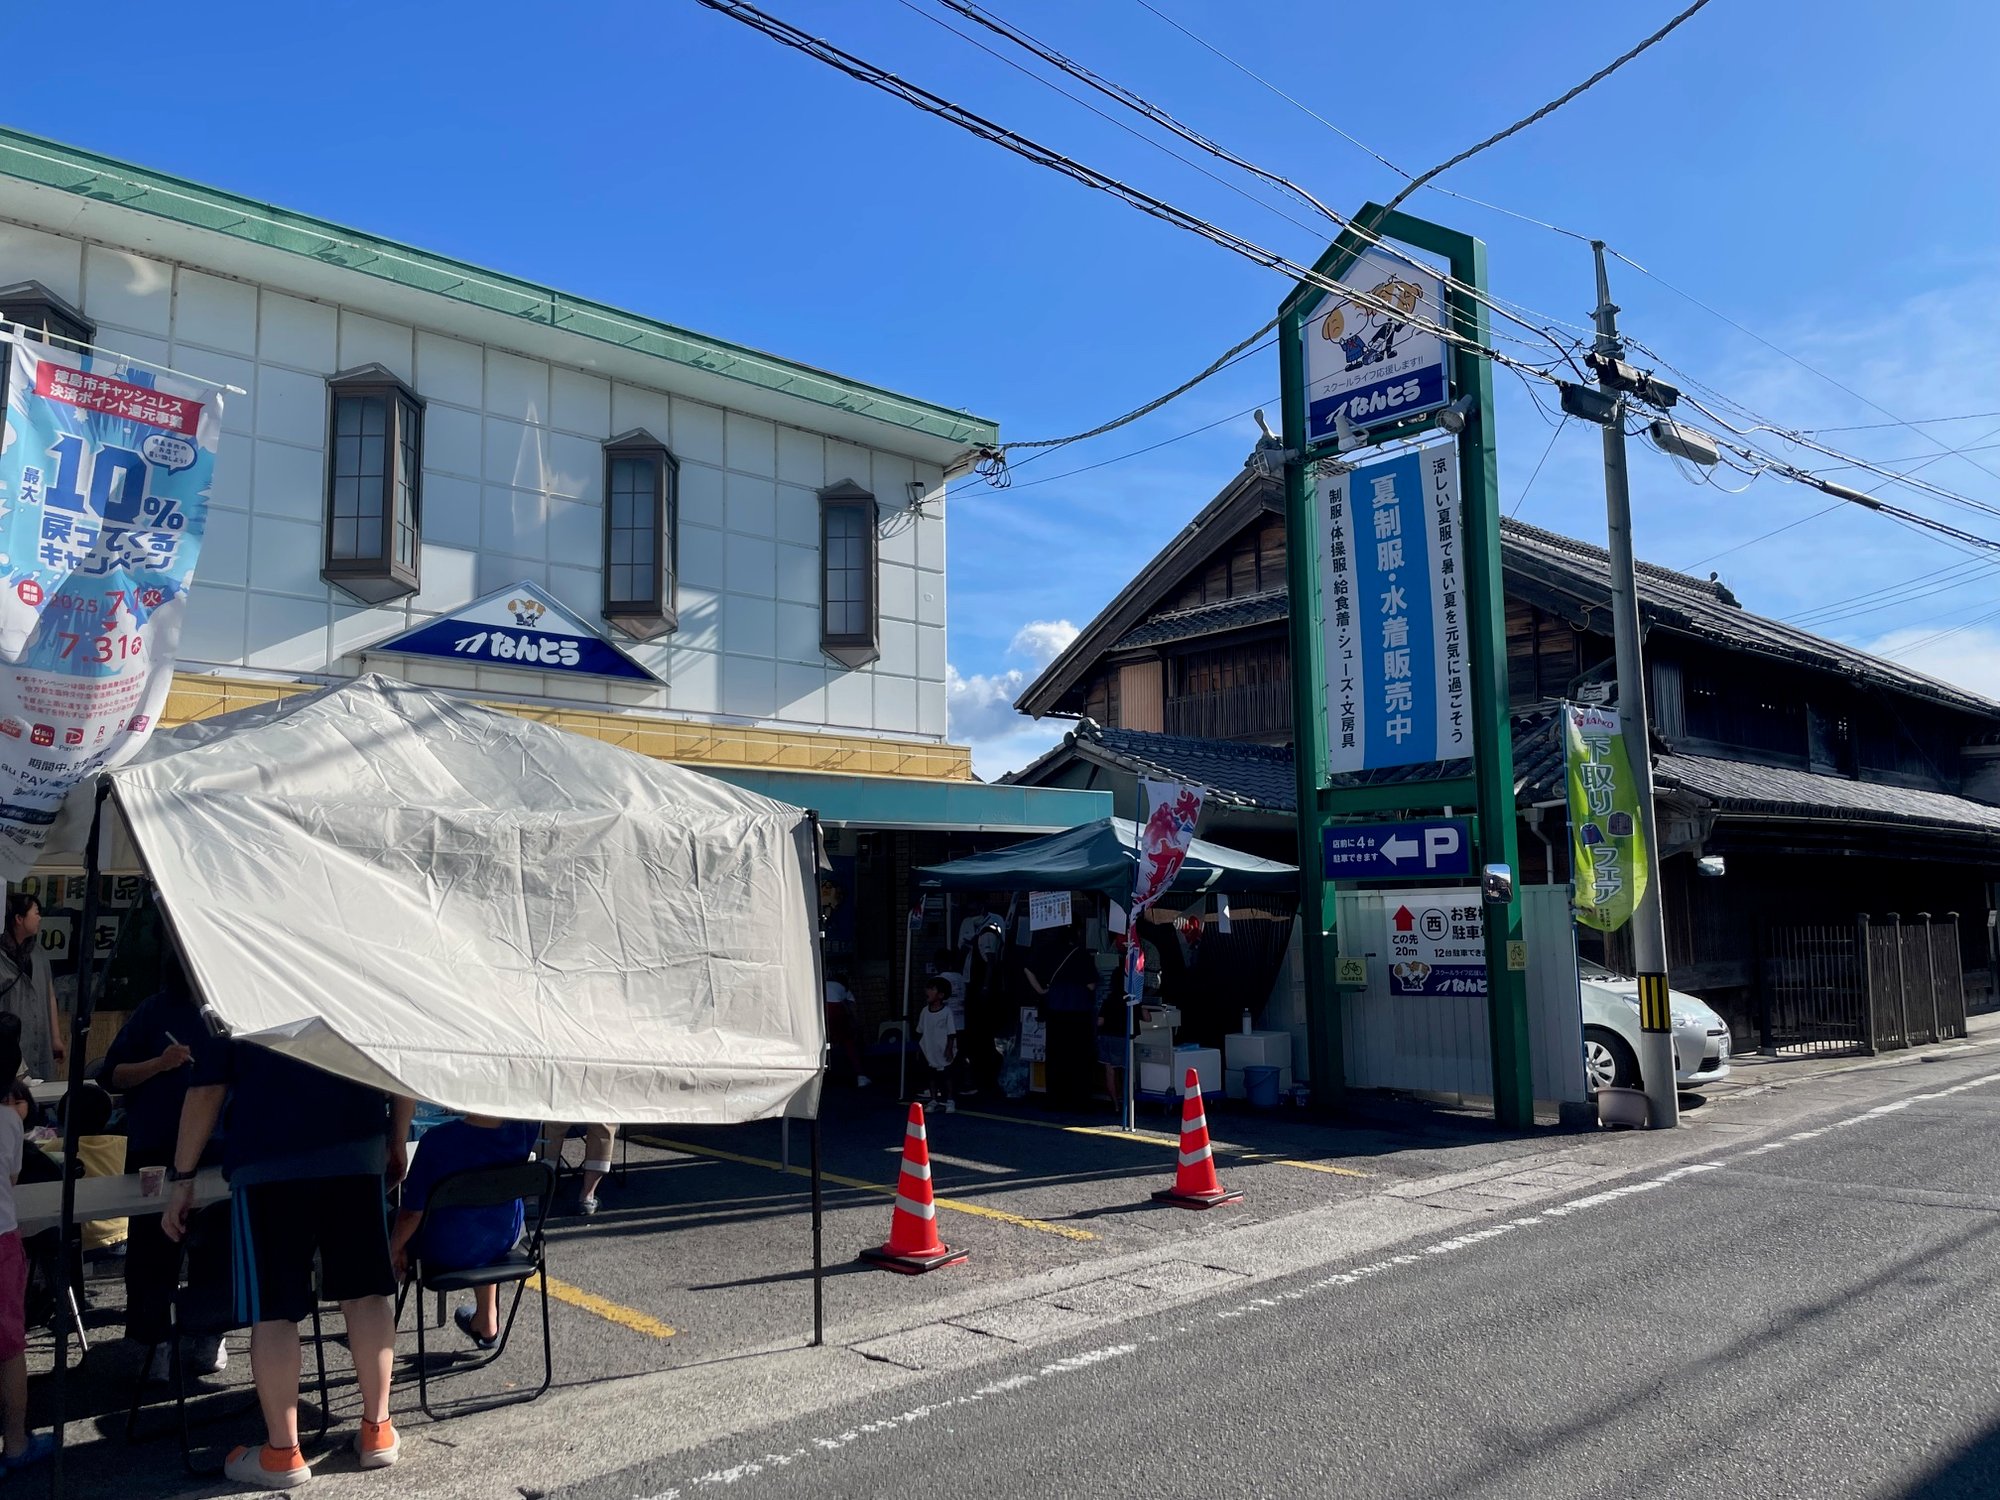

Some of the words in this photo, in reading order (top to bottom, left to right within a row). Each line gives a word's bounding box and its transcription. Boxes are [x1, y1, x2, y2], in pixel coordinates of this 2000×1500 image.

[54, 369, 183, 413] 徳島市キャッシュレス
[1323, 356, 1424, 394] スクールライフ応援します!!
[50, 383, 184, 429] 決済ポイント還元事業
[1350, 378, 1421, 418] なんとう
[20, 467, 40, 503] 最大
[46, 432, 185, 530] 10%
[41, 512, 179, 553] 戻ってくる
[40, 543, 173, 575] キャンペーン
[51, 594, 98, 613] 2025
[1328, 487, 1356, 748] 制服・体操服・給食着・シューズ・文房具
[1370, 472, 1413, 745] 夏制服・水着販売中
[1432, 457, 1464, 744] 涼しい夏服で暑い夏を元気に過ごそう
[59, 632, 128, 663] 7.31
[490, 632, 580, 666] なんとう
[1, 763, 16, 776] au
[20, 771, 49, 786] PAY
[1580, 736, 1616, 815] 下取り
[1332, 836, 1375, 849] 店前に4台
[1333, 853, 1379, 863] 駐車できます
[1424, 827, 1459, 868] P
[1593, 847, 1622, 904] フェア
[1392, 935, 1418, 944] この先
[1396, 947, 1418, 956] 20m
[1452, 925, 1485, 940] 駐車
